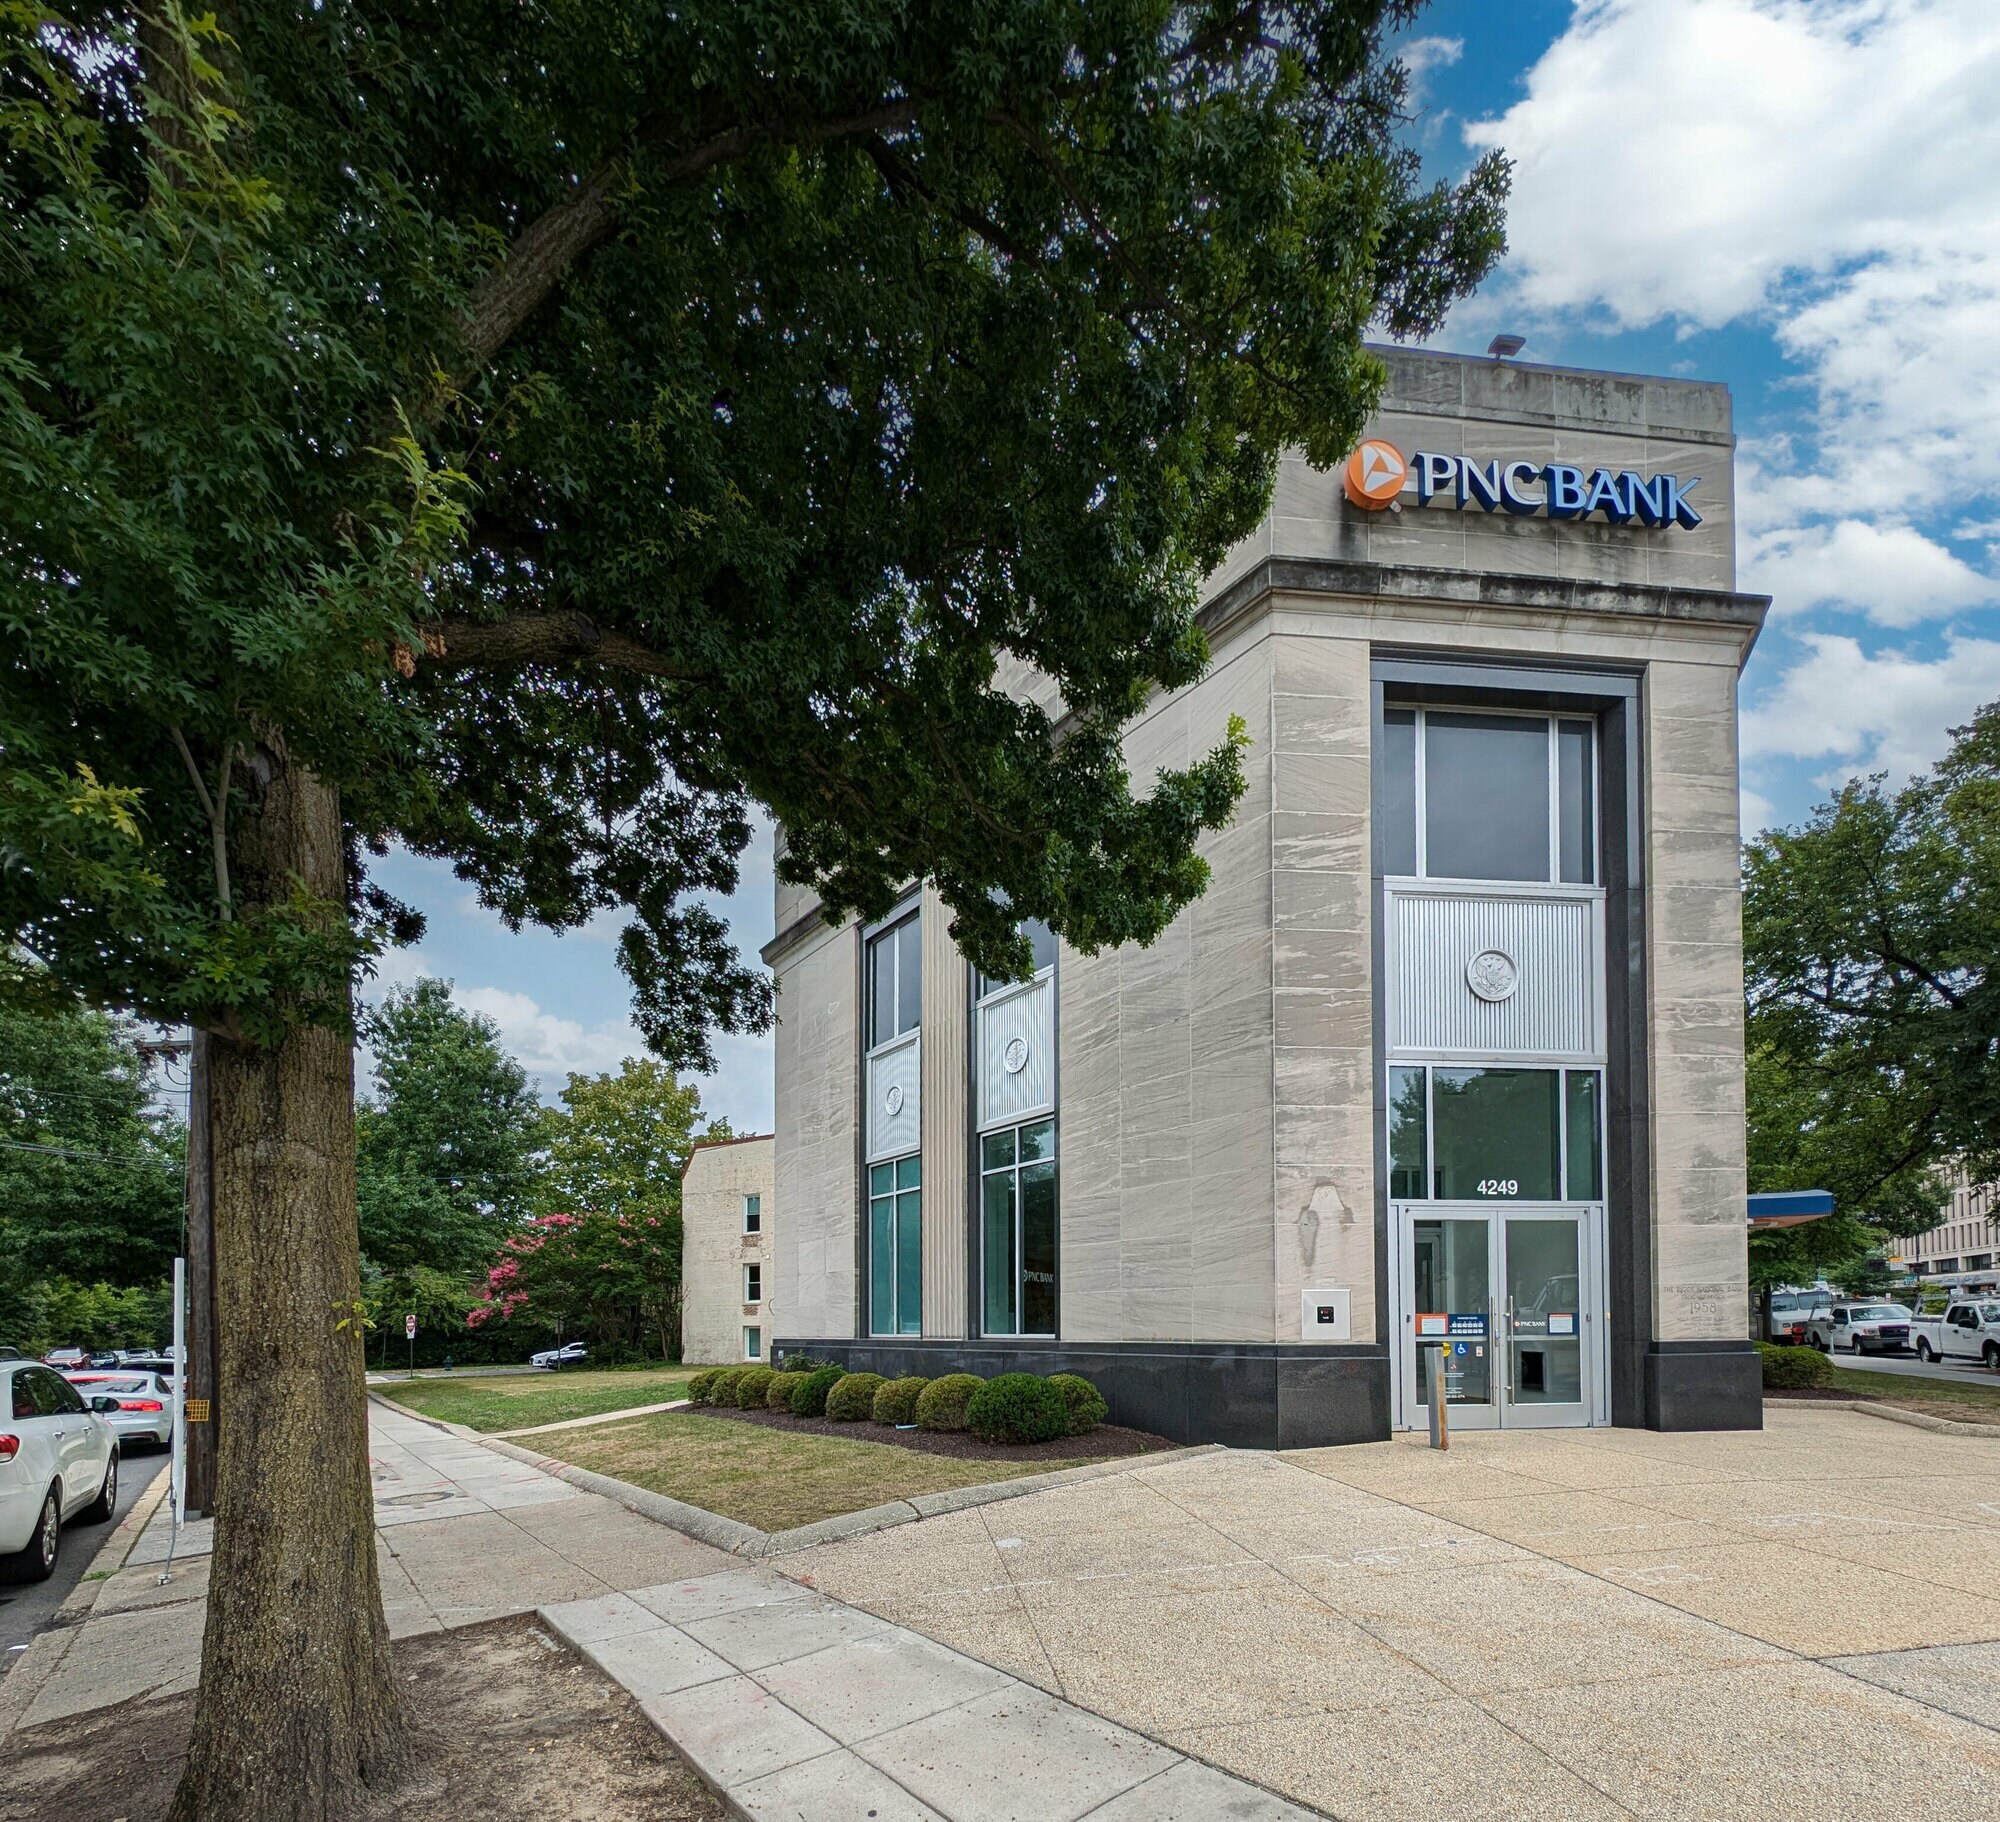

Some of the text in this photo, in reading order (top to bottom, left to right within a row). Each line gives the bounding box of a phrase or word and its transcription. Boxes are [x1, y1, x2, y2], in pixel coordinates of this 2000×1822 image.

[1411, 451, 1703, 530] PNC BANK
[1477, 1179, 1518, 1195] 4249
[1689, 1301, 1717, 1314] 1958
